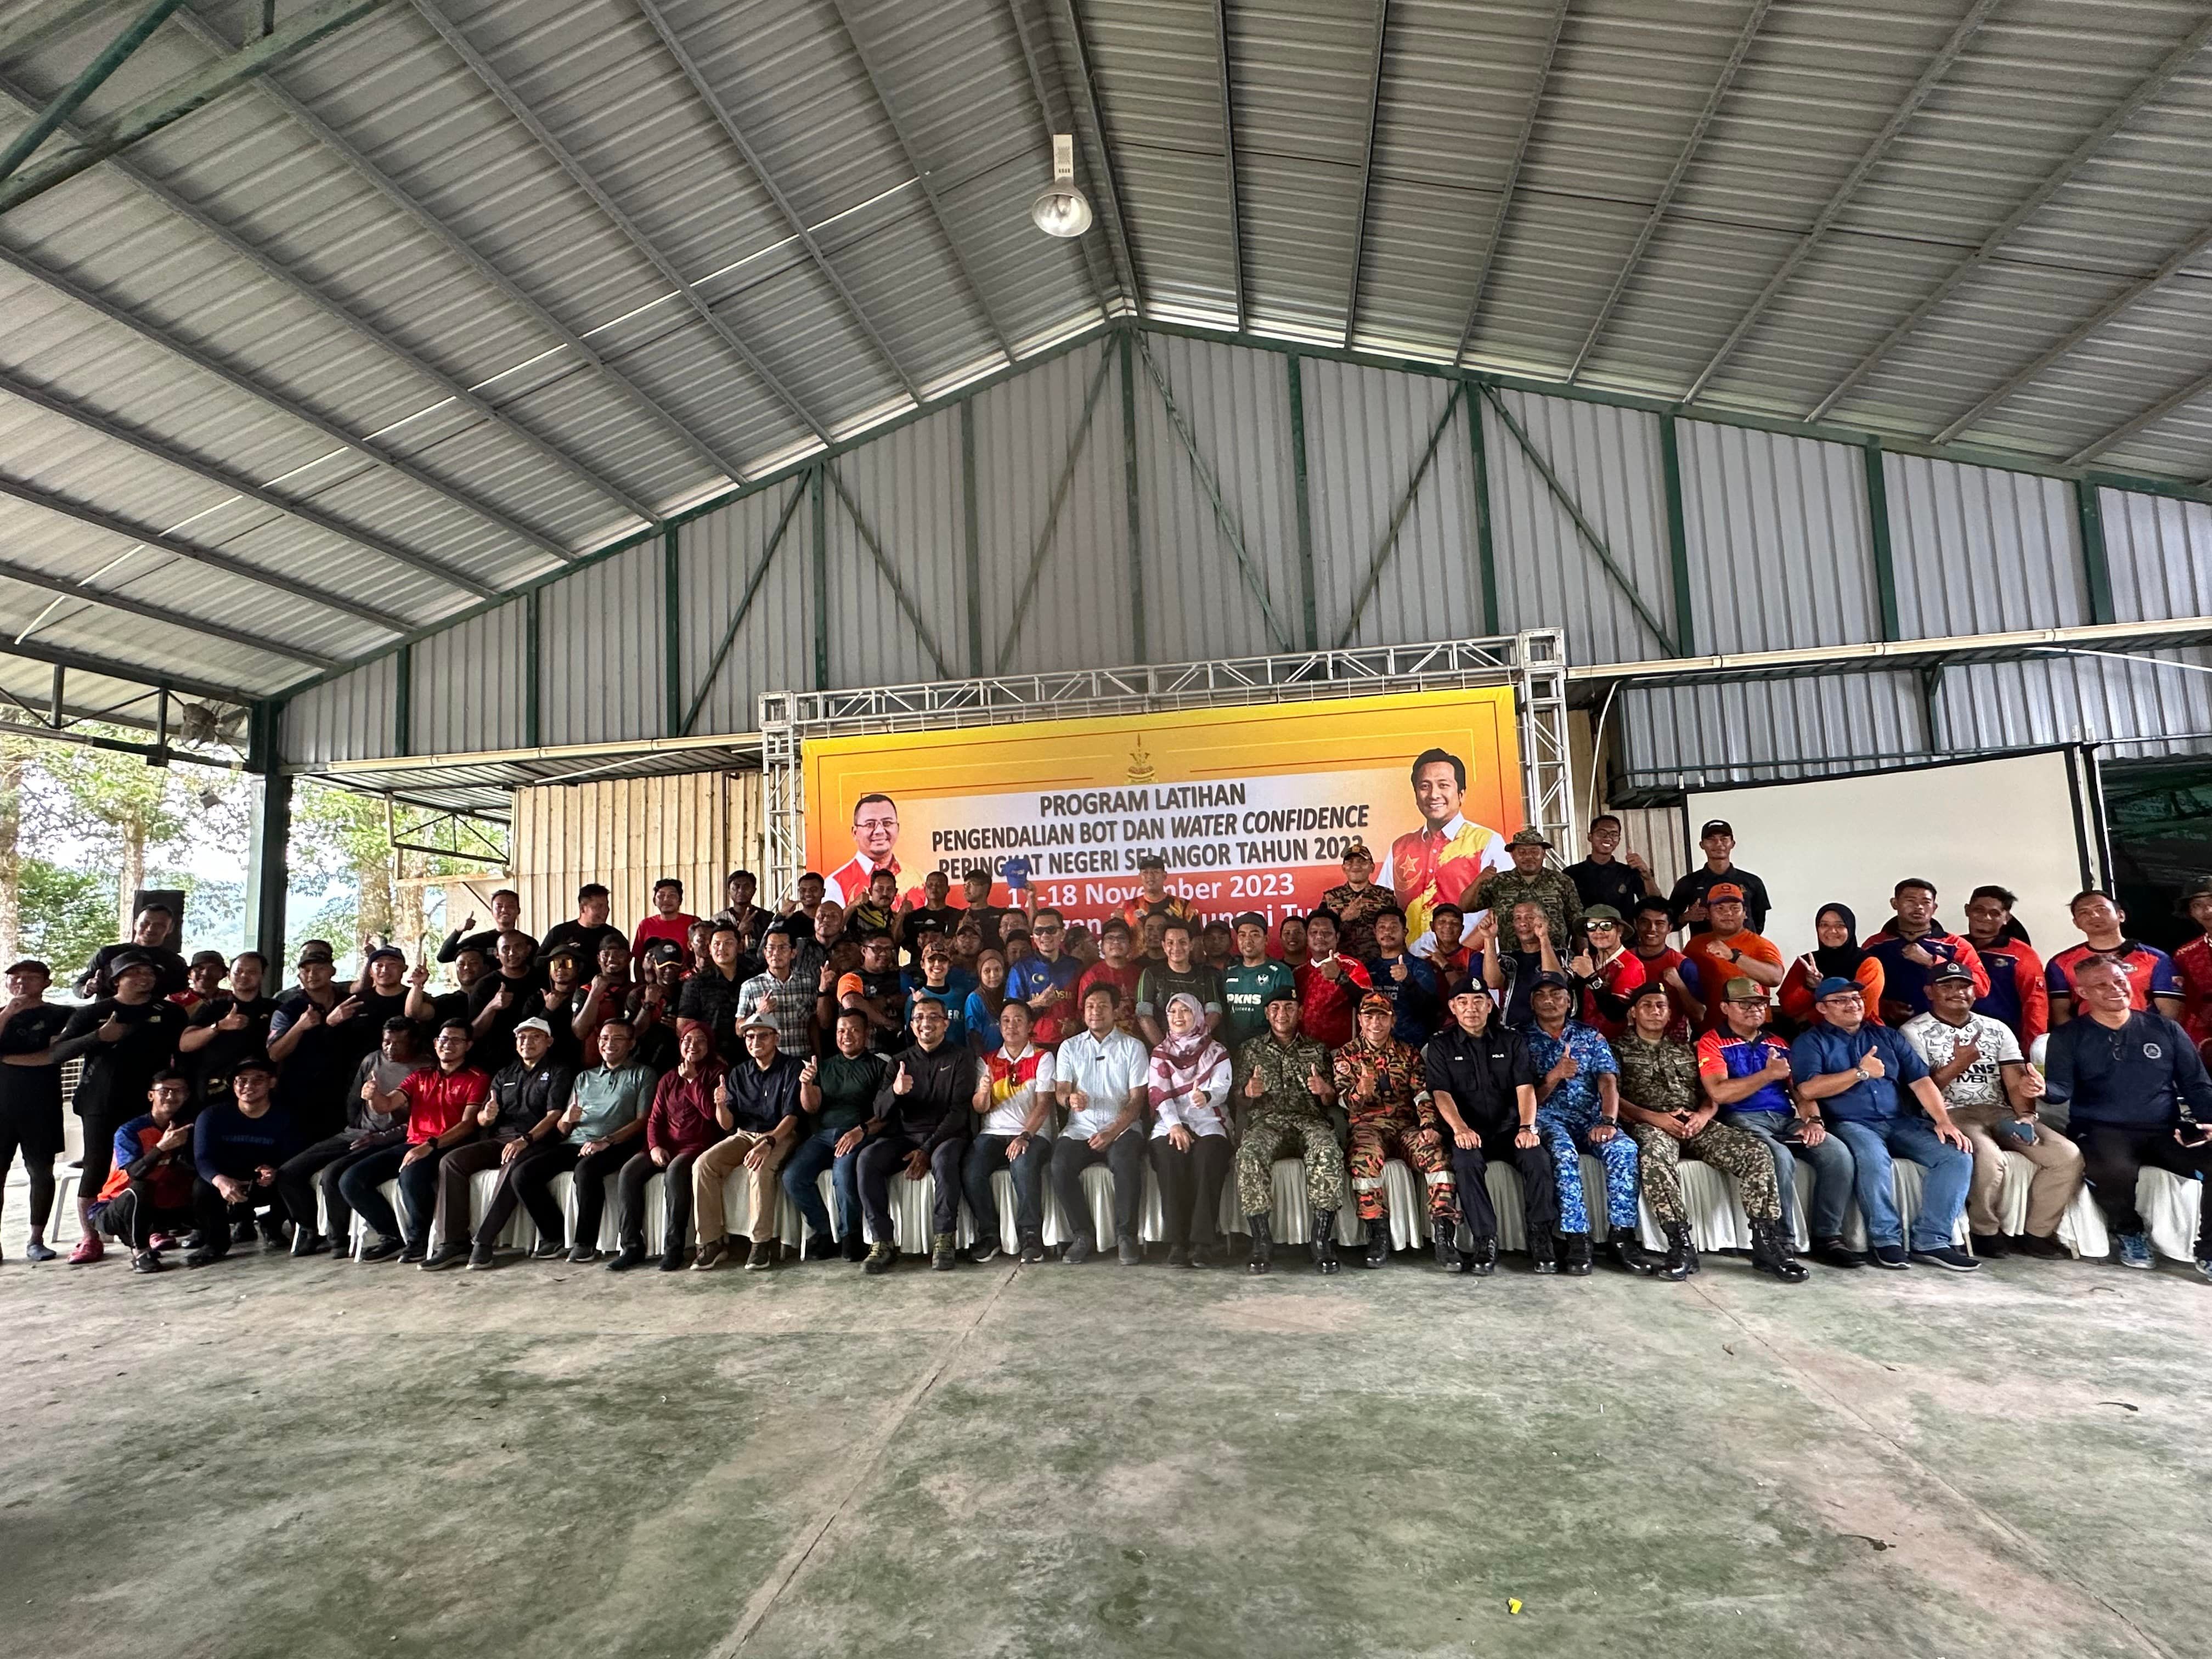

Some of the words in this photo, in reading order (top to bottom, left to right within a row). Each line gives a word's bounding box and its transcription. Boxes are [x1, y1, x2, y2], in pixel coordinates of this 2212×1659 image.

[1041, 790, 1148, 817] PROGRAM
[1155, 783, 1245, 810] LATIHAN
[932, 823, 1074, 851] PENGENDALIAN
[1080, 821, 1118, 843] BOT
[1123, 818, 1164, 841] DAN
[1171, 813, 1237, 838] WATER
[1243, 805, 1369, 833] CONFIDENCE
[939, 854, 1043, 879] PERINGAT
[1049, 849, 1118, 874] NEGERI
[1236, 838, 1308, 864] TAHUN
[1008, 885, 1077, 909] 1-18
[1229, 873, 1295, 898] 2023
[1226, 993, 1262, 1005] PKNS
